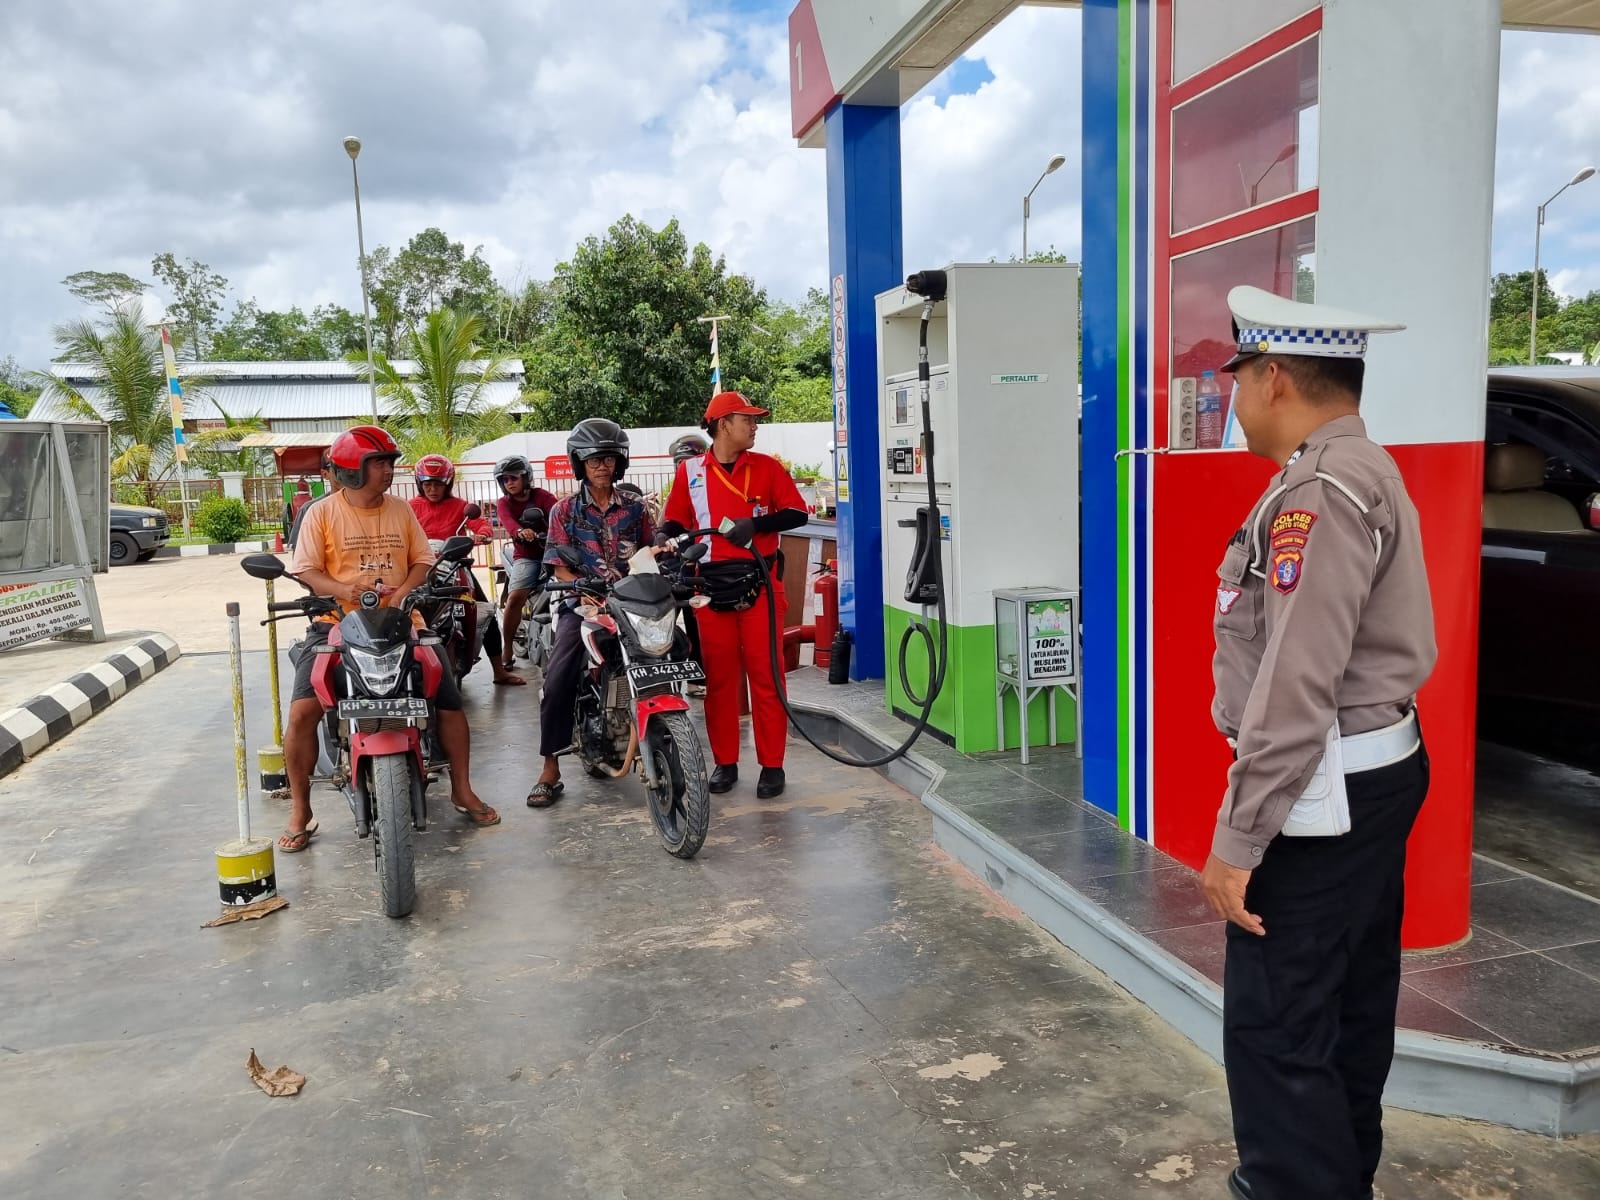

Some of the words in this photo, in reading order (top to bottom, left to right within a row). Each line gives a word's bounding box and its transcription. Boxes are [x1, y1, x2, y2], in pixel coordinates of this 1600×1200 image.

[794, 41, 803, 92] 1
[1000, 375, 1039, 383] PERTALITE
[1273, 513, 1312, 527] POLRES
[35, 591, 77, 608] MAKSIMAL
[25, 607, 53, 621] DALAM
[53, 599, 82, 613] SEHARI
[9, 626, 31, 636] MOBIL
[26, 628, 51, 641] MOTOR
[1035, 638, 1065, 649] 100%
[1030, 650, 1046, 658] UNTUK
[1034, 658, 1066, 667] MUSLIMIN
[631, 667, 648, 679] KH
[652, 664, 680, 675] 3429
[683, 662, 696, 671] EP
[342, 701, 360, 711] KH
